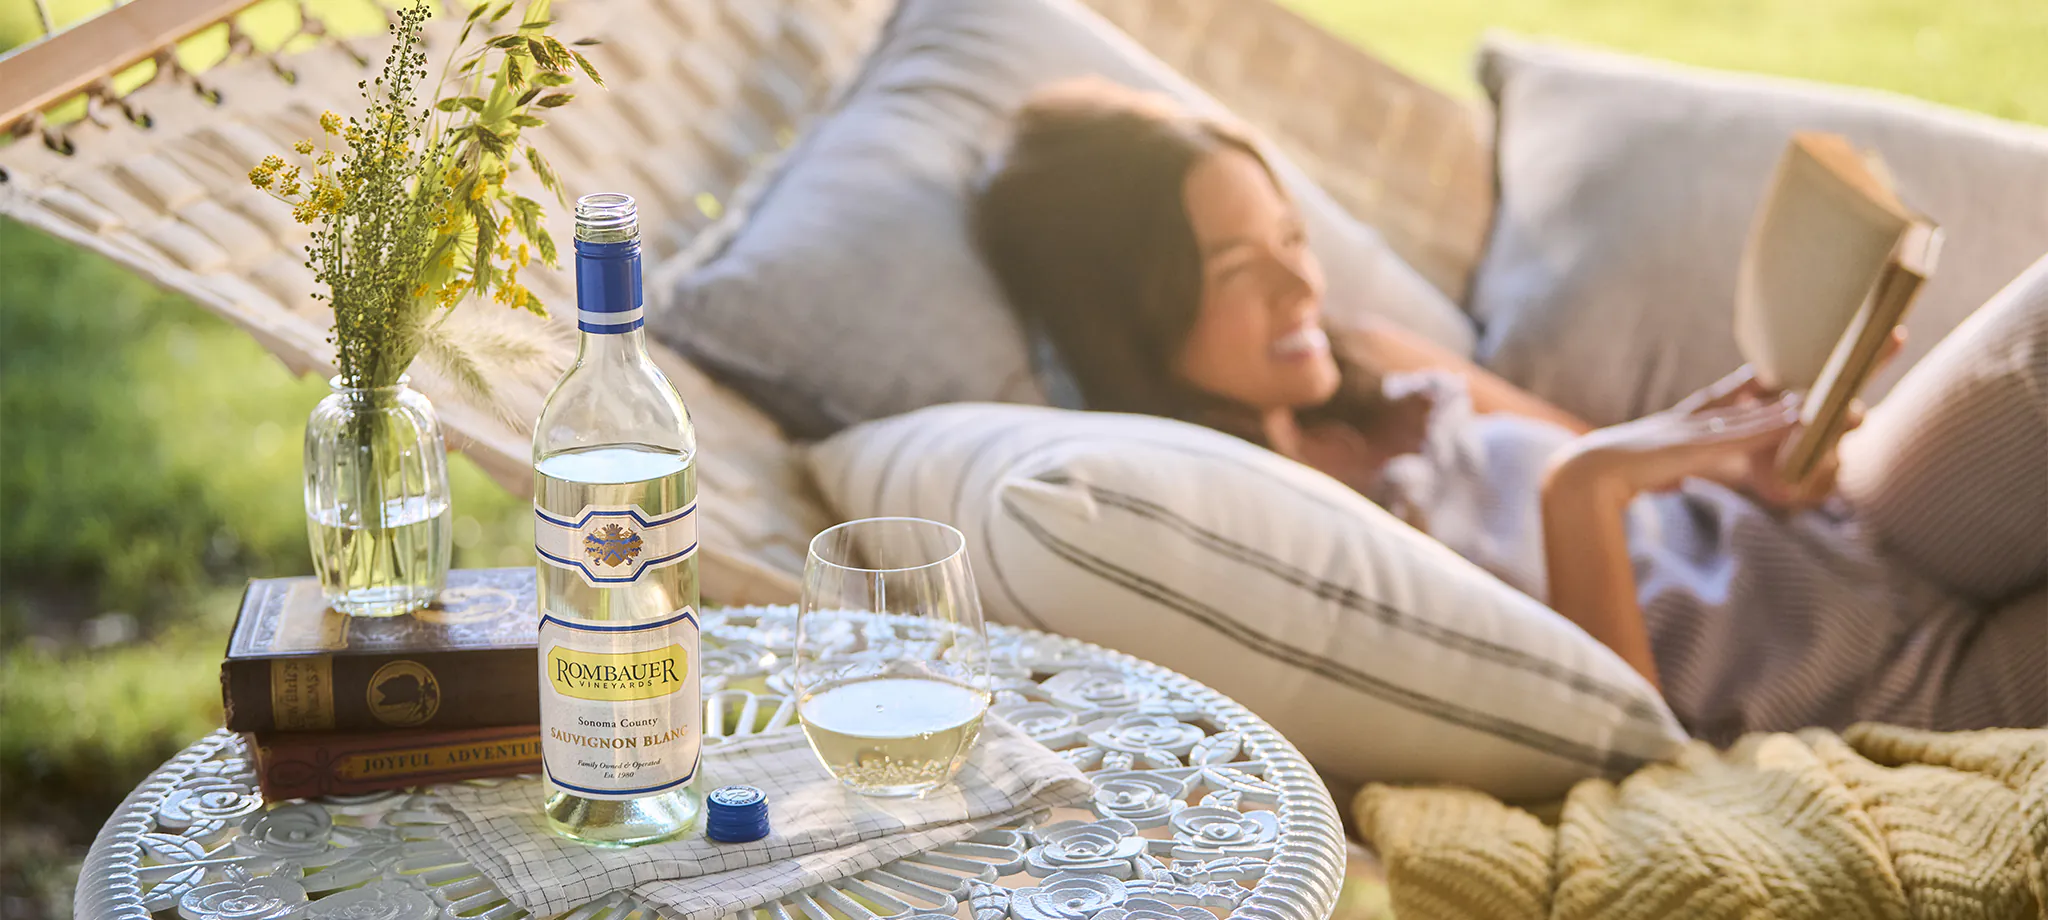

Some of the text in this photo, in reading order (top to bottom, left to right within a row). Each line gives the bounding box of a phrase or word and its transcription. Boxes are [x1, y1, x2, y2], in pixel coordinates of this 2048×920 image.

[556, 657, 679, 688] ROMBAUER
[579, 680, 653, 689] VINEYARDS
[578, 716, 658, 728] Sonoma County
[551, 724, 688, 749] SAUVIGNON BLANC
[363, 754, 433, 773] JOYFUL
[577, 758, 661, 769] Family Owned & Operated
[617, 771, 634, 779] 1980
